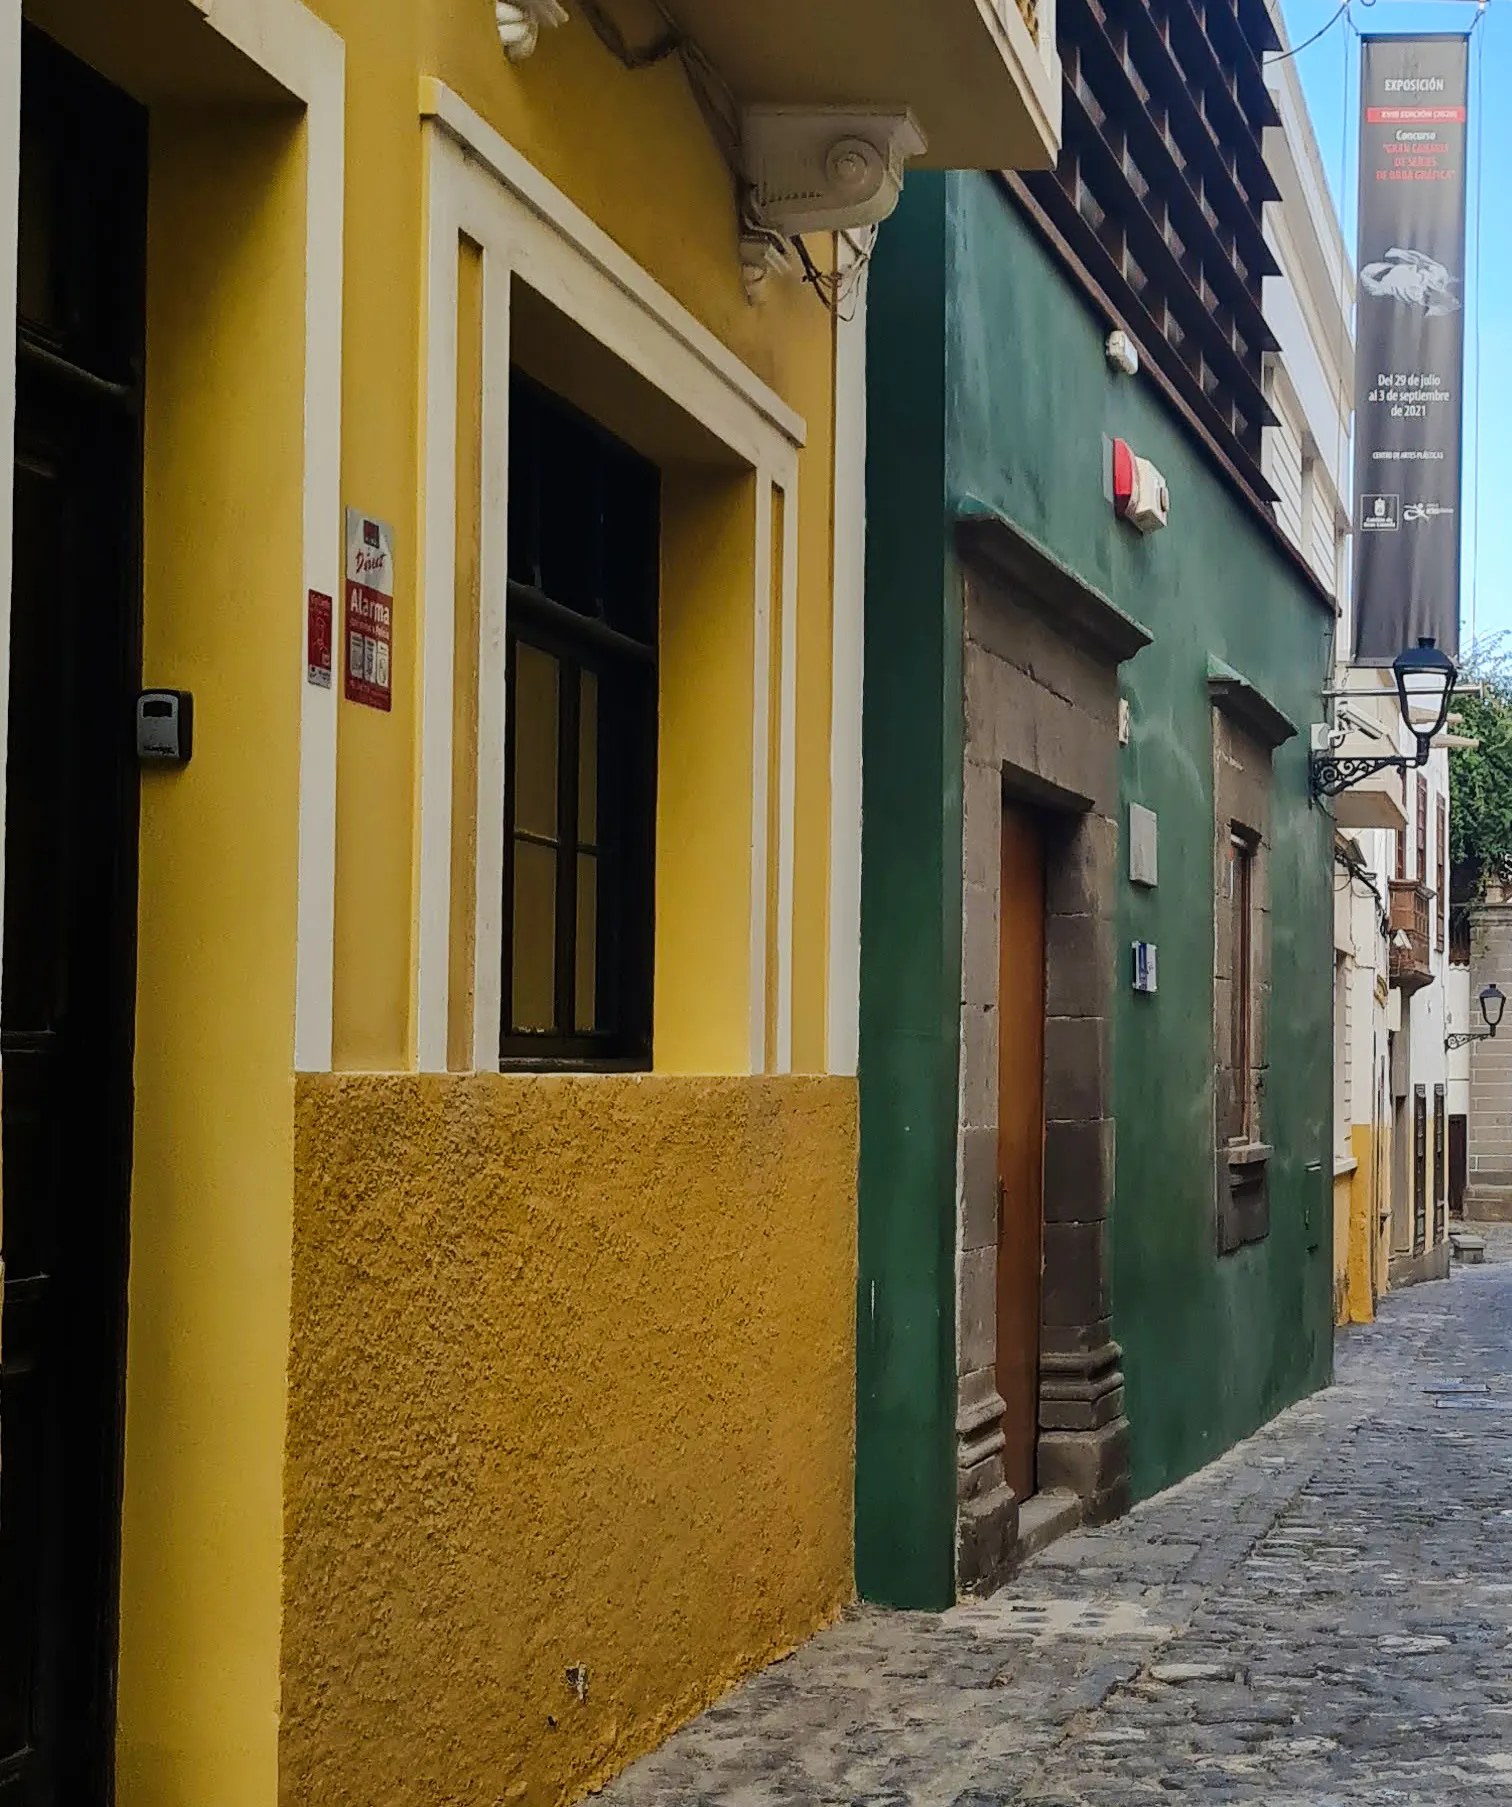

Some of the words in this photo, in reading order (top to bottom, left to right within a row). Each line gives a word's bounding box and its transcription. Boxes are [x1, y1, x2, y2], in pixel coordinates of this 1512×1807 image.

[1385, 77, 1444, 91] EXPOSICIÓN
[1395, 129, 1436, 141] Concurso
[1378, 373, 1394, 386] Del
[1394, 374, 1406, 386] 29
[1408, 373, 1419, 386] de
[1420, 374, 1440, 389] julio
[1368, 389, 1377, 401] al
[1378, 390, 1385, 401] 3
[1386, 389, 1398, 401] de
[1399, 389, 1450, 404] septiembre
[1390, 404, 1403, 416] de
[1404, 405, 1426, 416] 2021
[350, 588, 390, 626] Alarma
